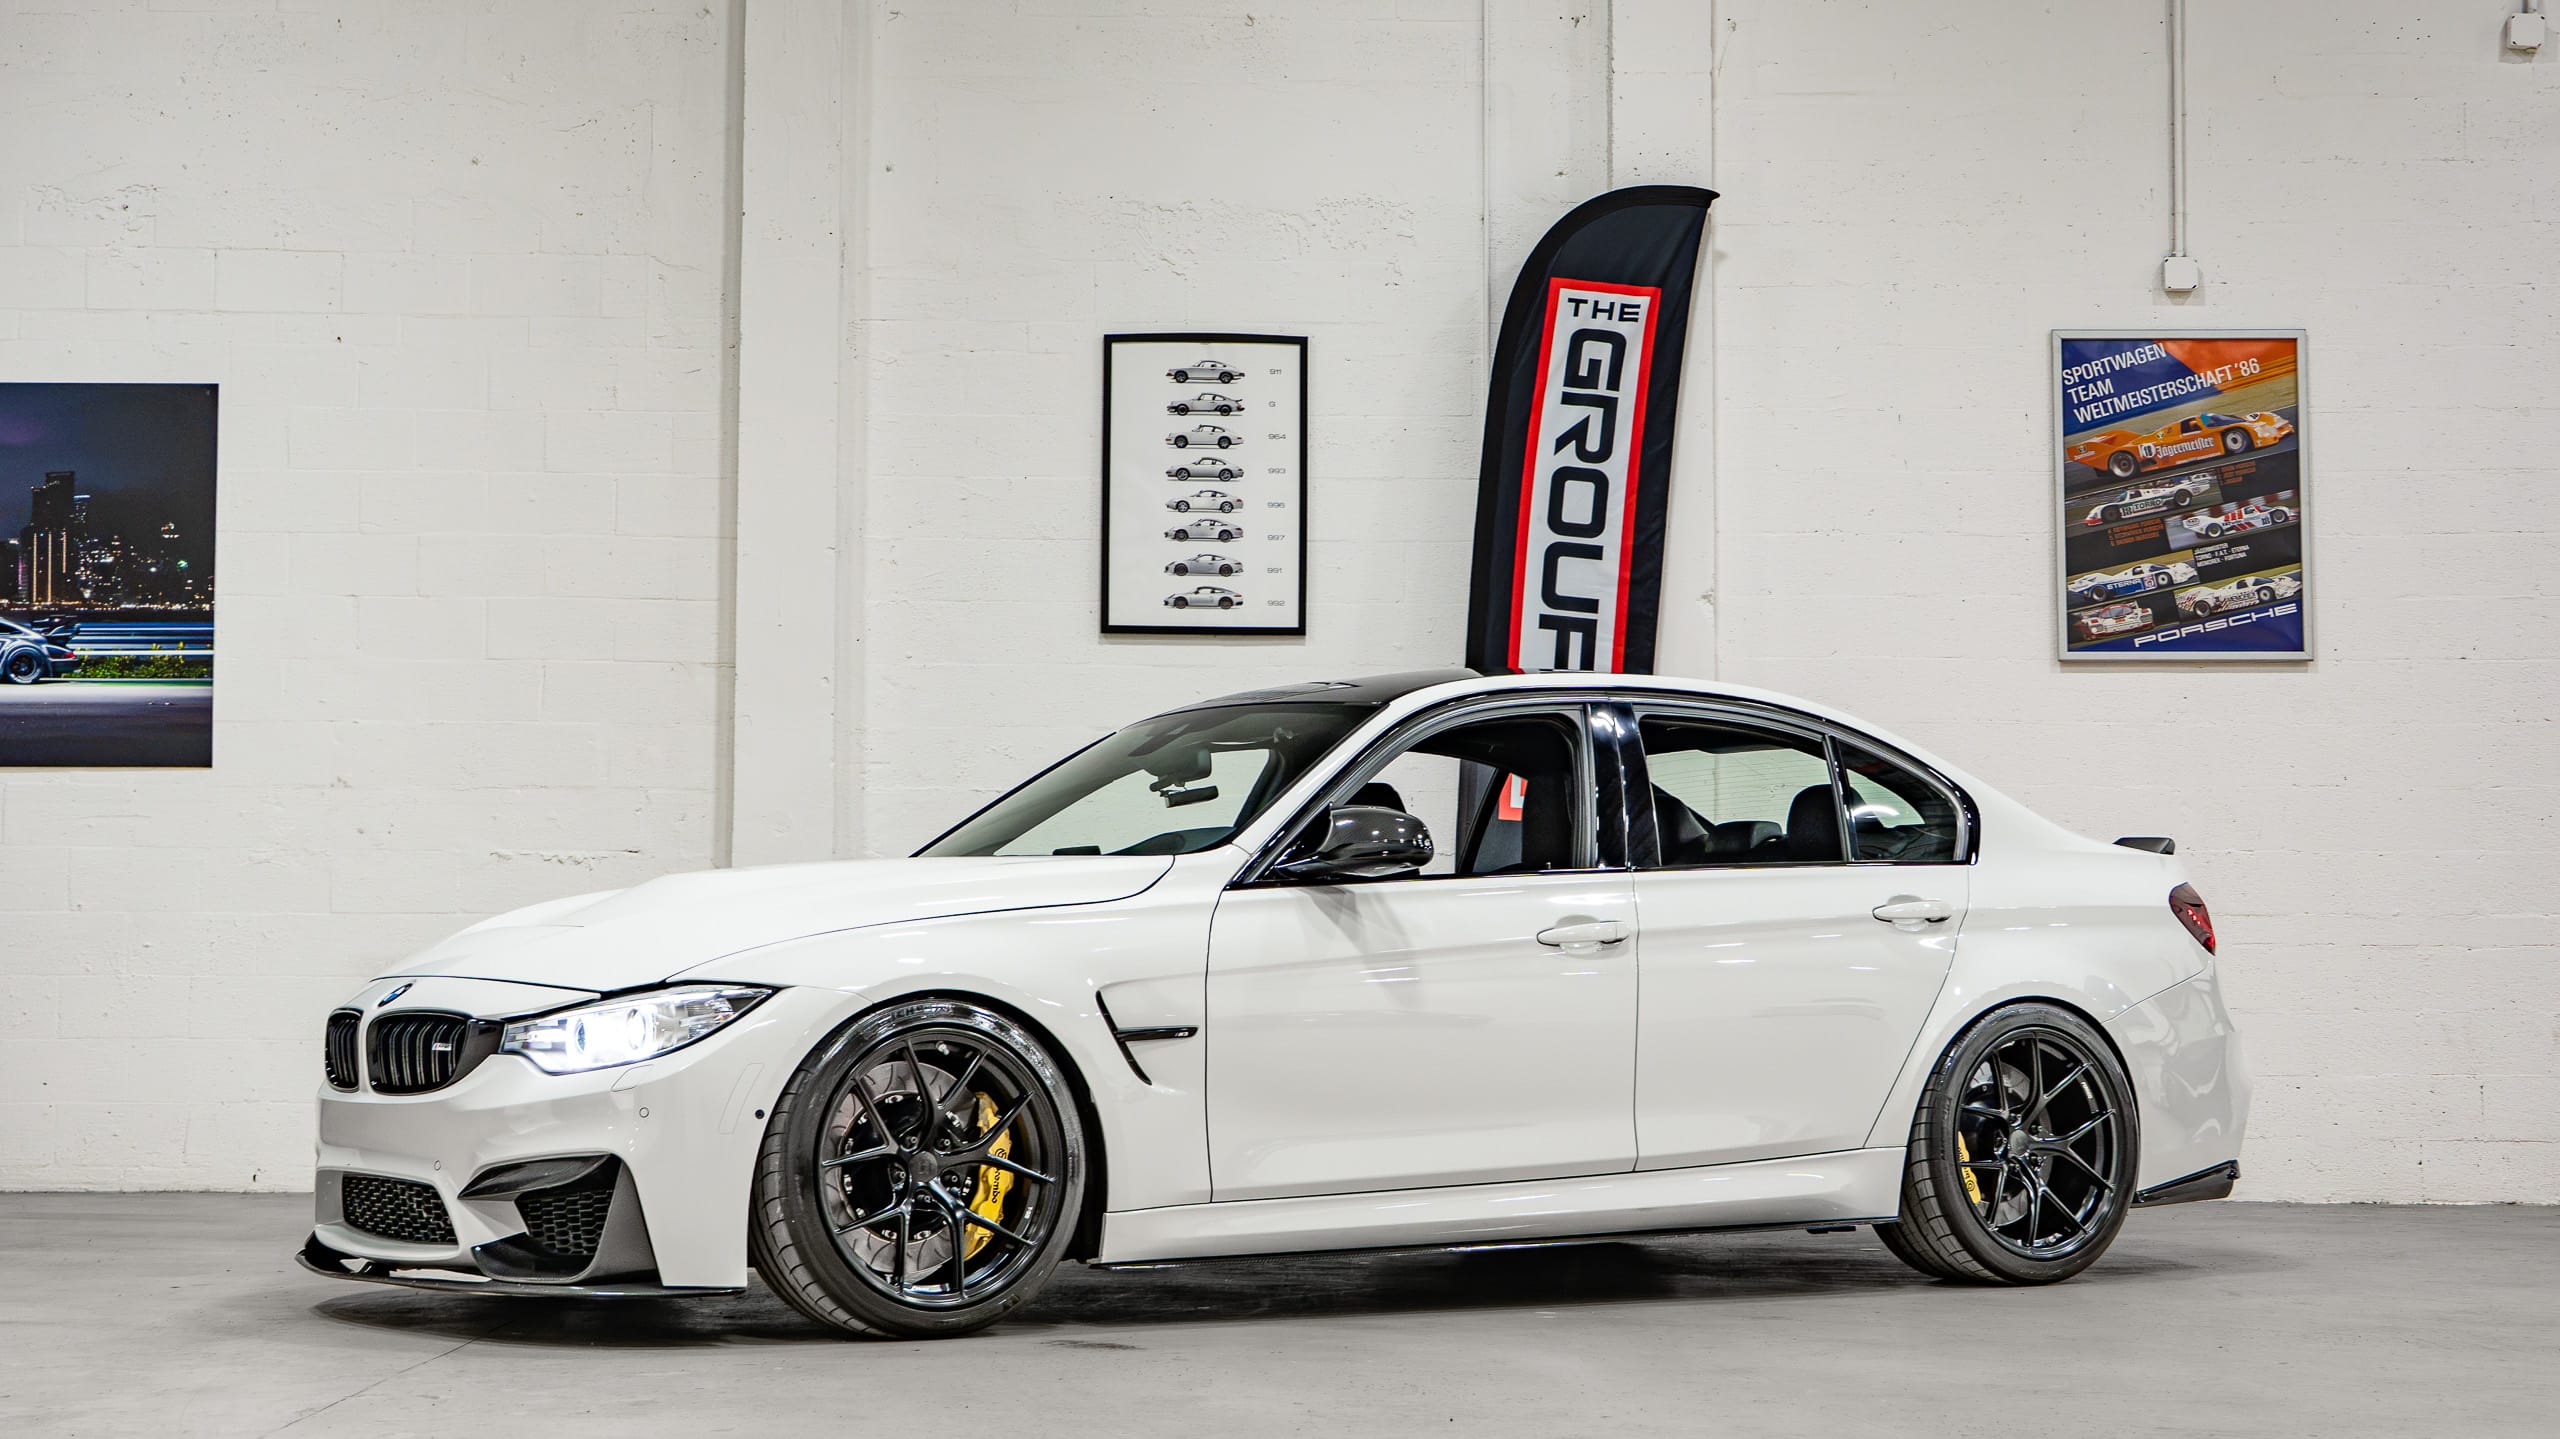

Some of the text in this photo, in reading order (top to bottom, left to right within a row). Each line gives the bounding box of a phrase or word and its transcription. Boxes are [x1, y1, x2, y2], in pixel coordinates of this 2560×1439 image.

[1567, 297, 1641, 324] THE
[2062, 342, 2168, 386] SPORTWAGEN
[2067, 378, 2115, 405] TEAM
[2073, 357, 2261, 424] WELTMEISTERSCHAFT '86
[2133, 603, 2298, 648] PORSCHE
[991, 1166, 1001, 1204] rembo
